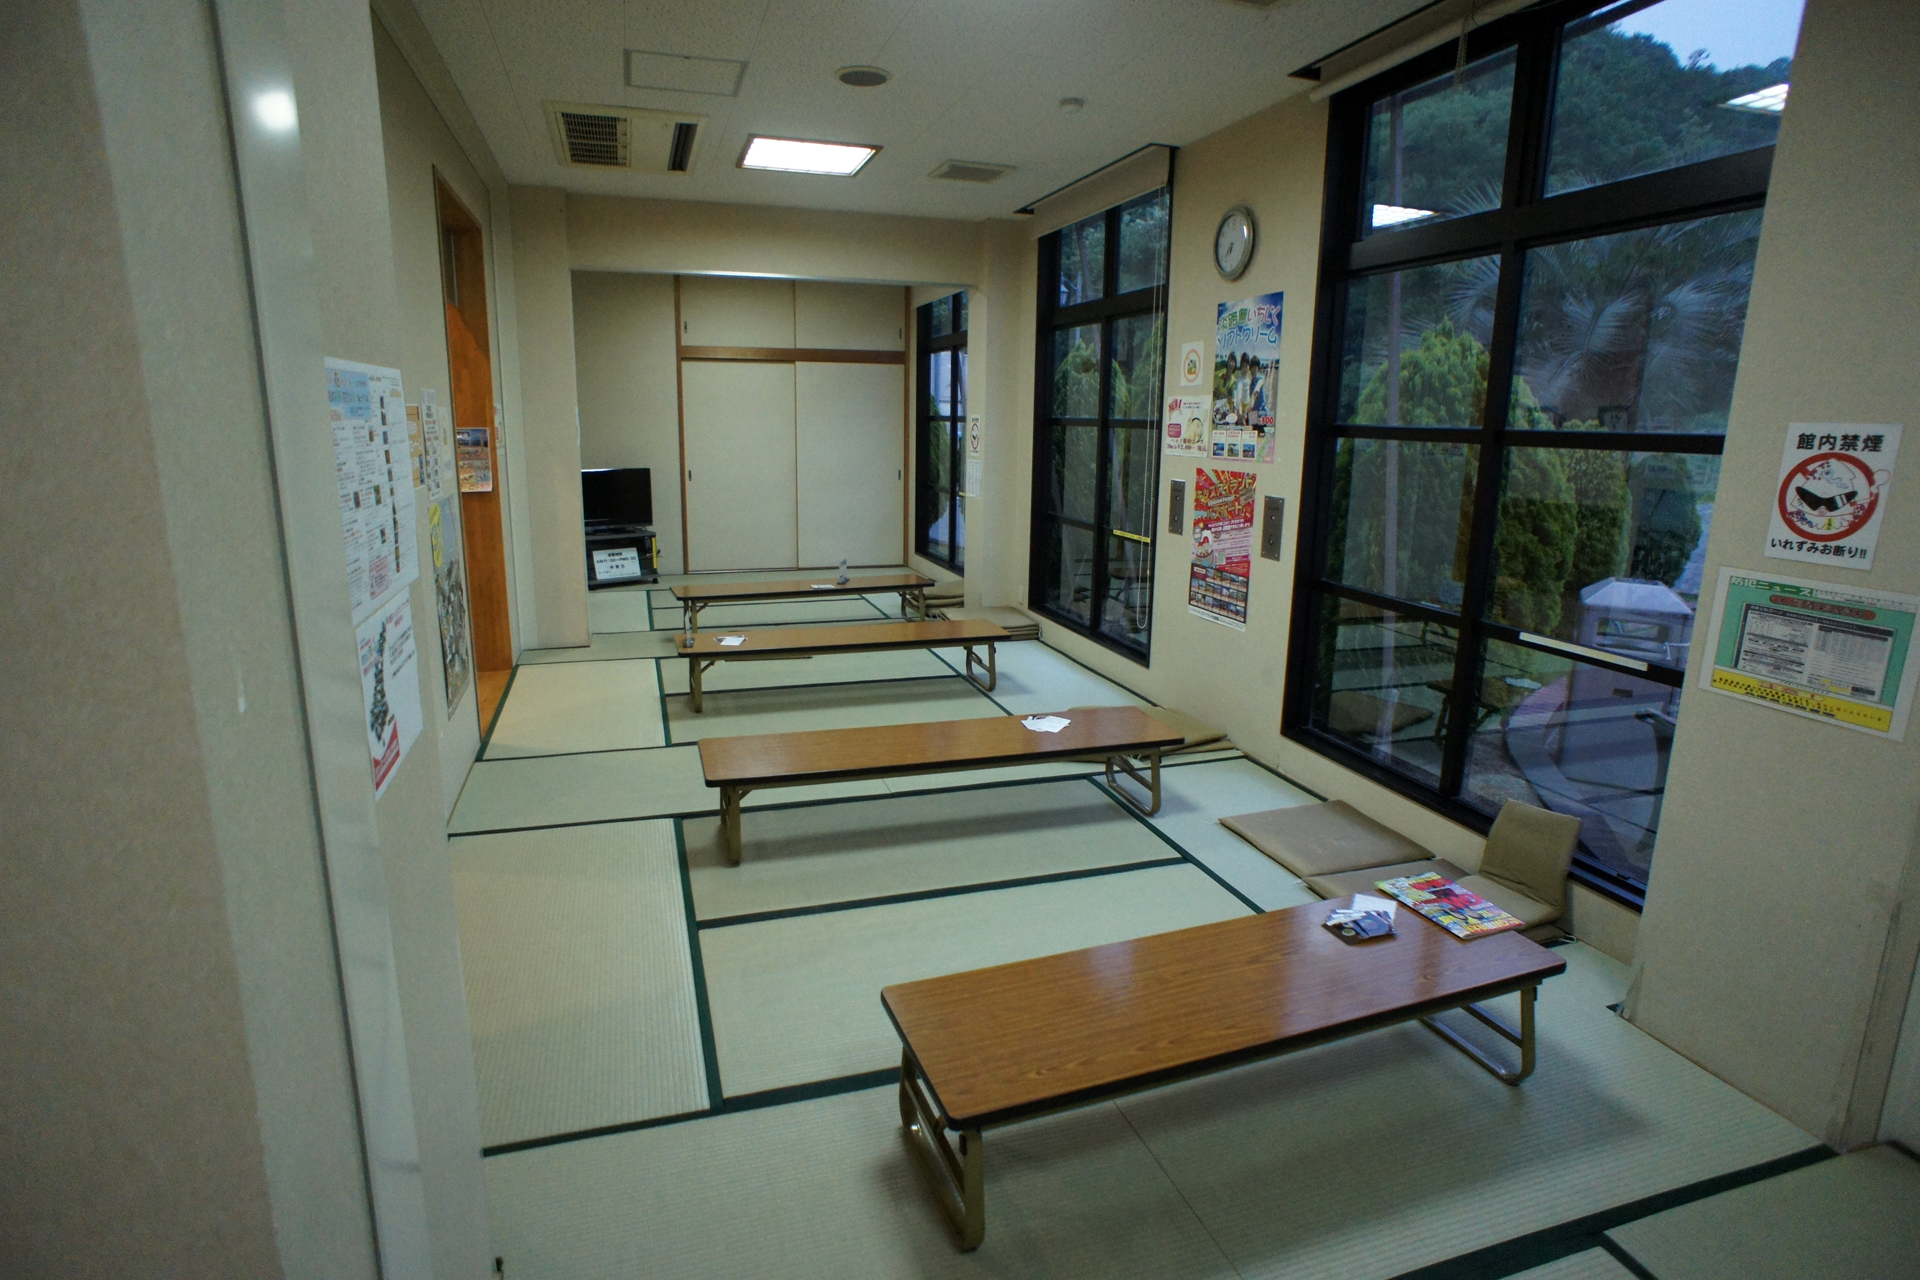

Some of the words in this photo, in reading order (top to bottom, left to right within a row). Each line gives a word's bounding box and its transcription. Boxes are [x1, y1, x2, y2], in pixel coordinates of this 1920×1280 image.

[1217, 326, 1278, 349] ソフトクリーム
[1796, 433, 1885, 452] 館内禁煙
[1771, 538, 1867, 559] いれずみお断り!!
[1730, 576, 1812, 597] 防犯ニュース
